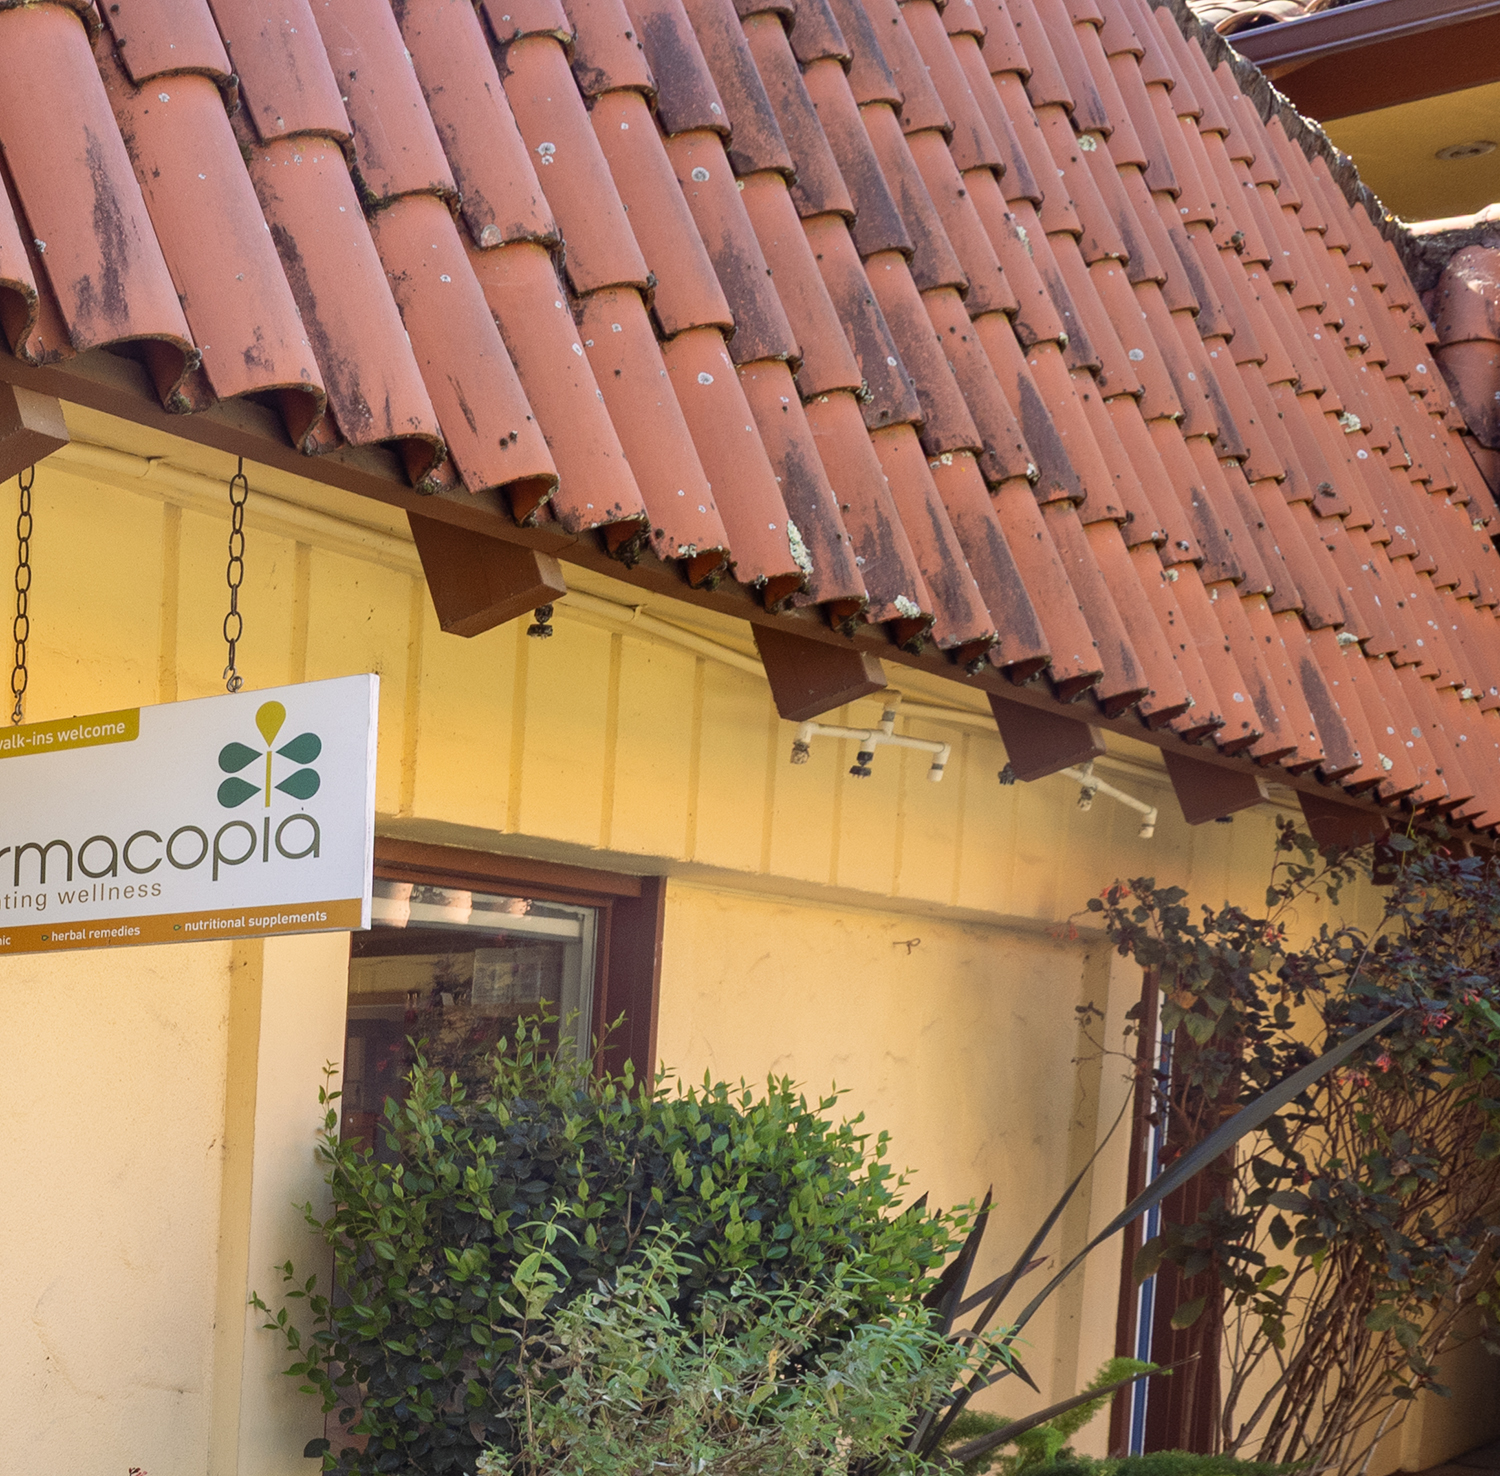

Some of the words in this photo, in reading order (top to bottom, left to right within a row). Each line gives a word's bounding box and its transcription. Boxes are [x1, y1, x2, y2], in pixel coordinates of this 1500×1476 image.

[58, 720, 125, 742] welcome
[58, 882, 162, 903] wellness
[51, 928, 86, 942] herbal
[88, 925, 140, 939] remedies
[184, 915, 246, 932] nutritional
[248, 909, 327, 928] supplements
